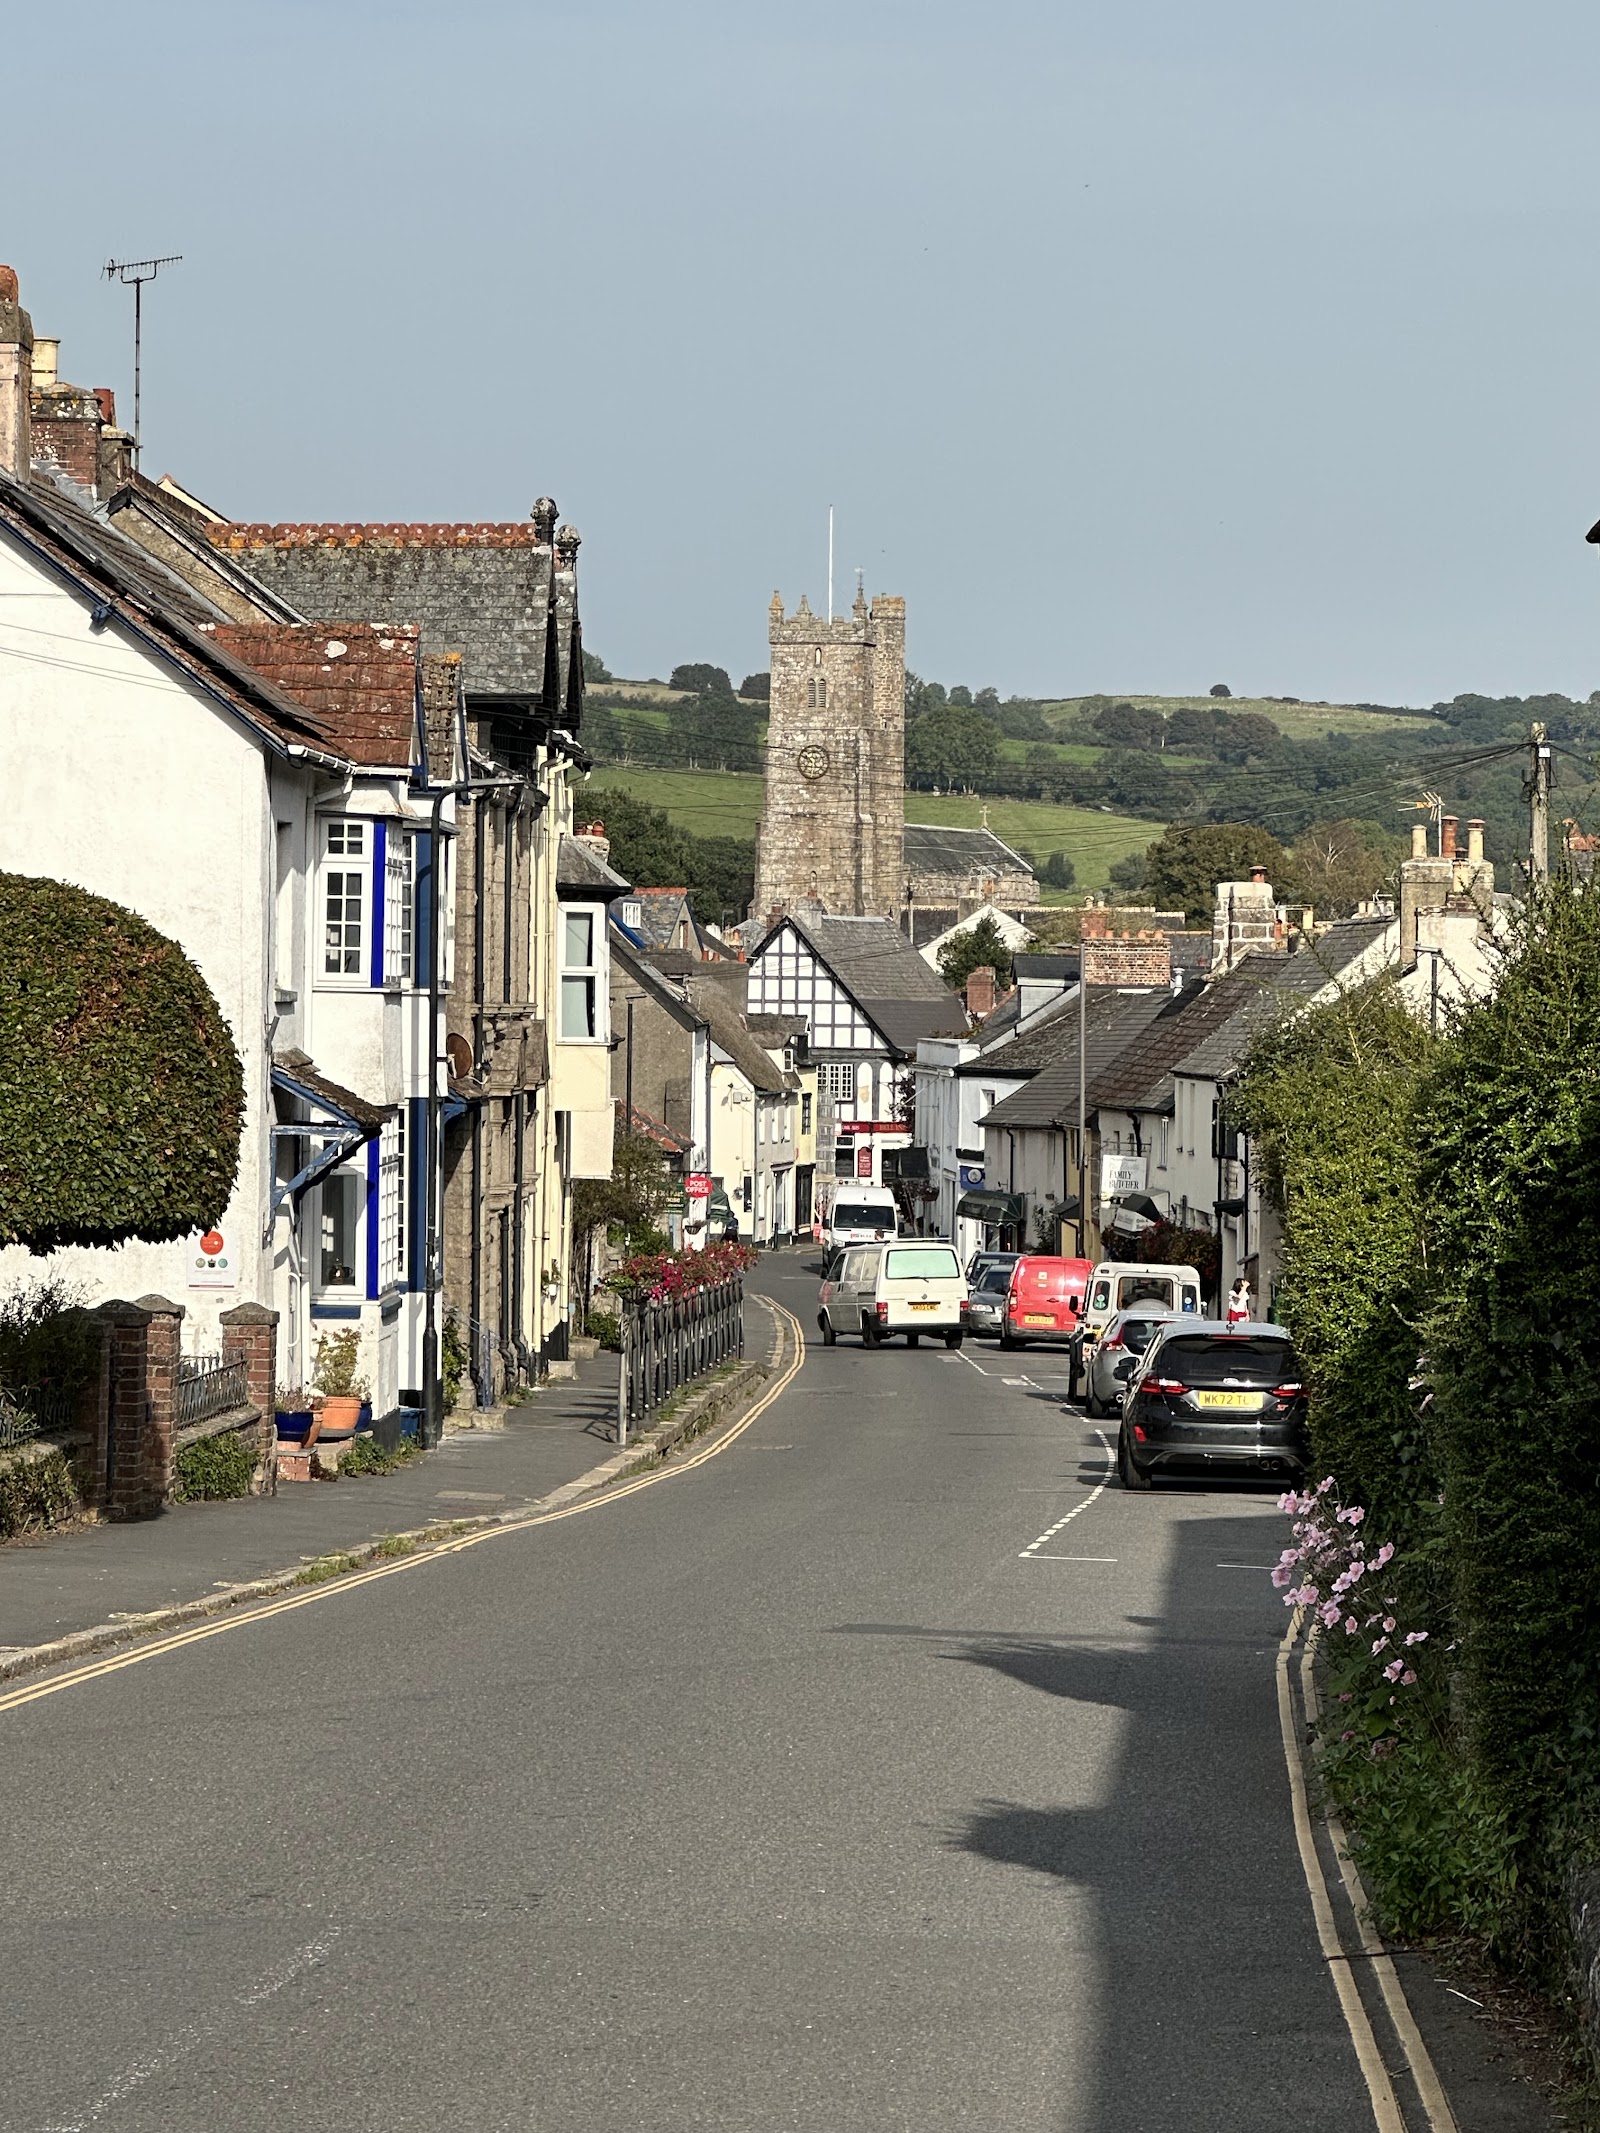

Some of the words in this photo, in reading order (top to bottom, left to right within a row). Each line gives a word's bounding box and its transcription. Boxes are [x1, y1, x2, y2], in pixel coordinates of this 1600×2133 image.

[1110, 1170, 1131, 1180] FAMILY
[1109, 1179, 1139, 1190] BUTCHER
[685, 1186, 709, 1194] OFFICE
[1204, 1394, 1233, 1405] WK72
